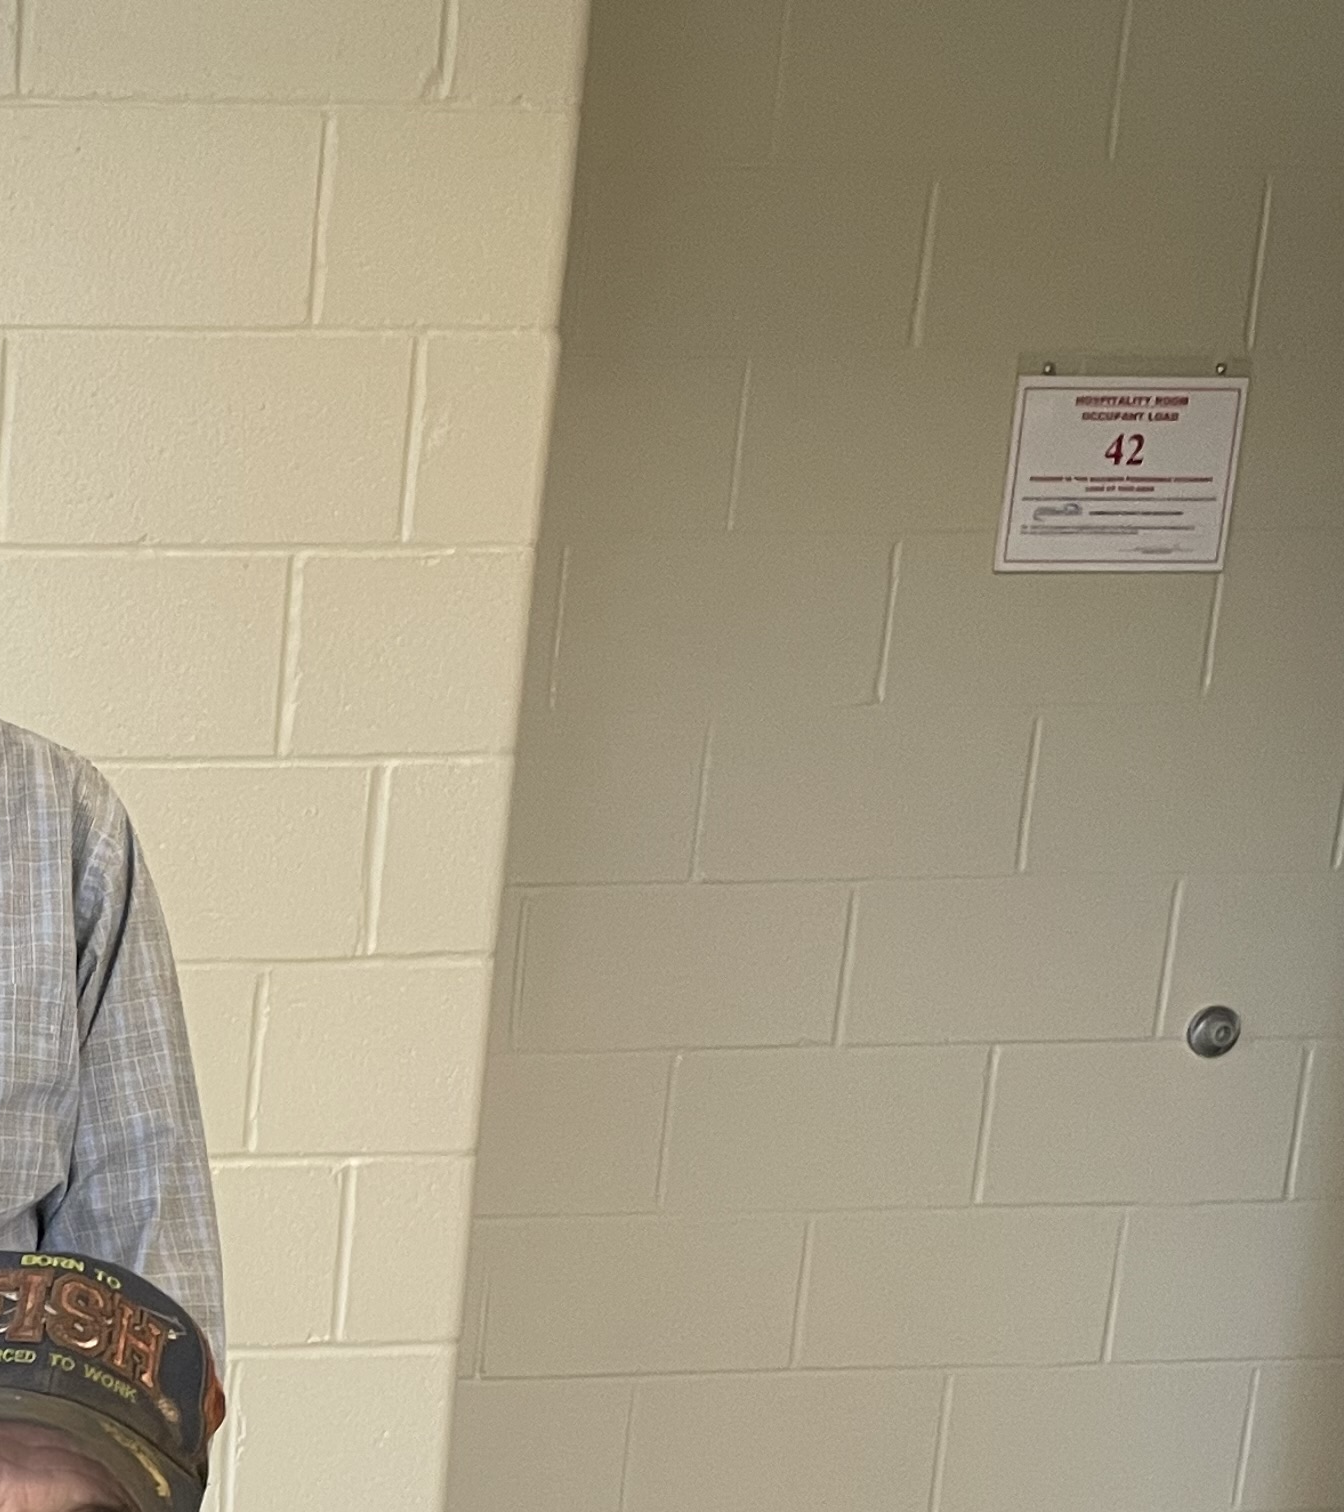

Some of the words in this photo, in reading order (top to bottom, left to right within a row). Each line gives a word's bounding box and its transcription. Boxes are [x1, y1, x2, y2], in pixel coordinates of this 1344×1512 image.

[1081, 411, 1144, 421] OCCUPANT
[1148, 412, 1179, 422] LOAD
[1104, 433, 1145, 466] 42
[20, 1253, 85, 1273] BORN
[95, 1269, 122, 1290] TO
[49, 1352, 76, 1372] TO
[83, 1366, 138, 1404] WORK
